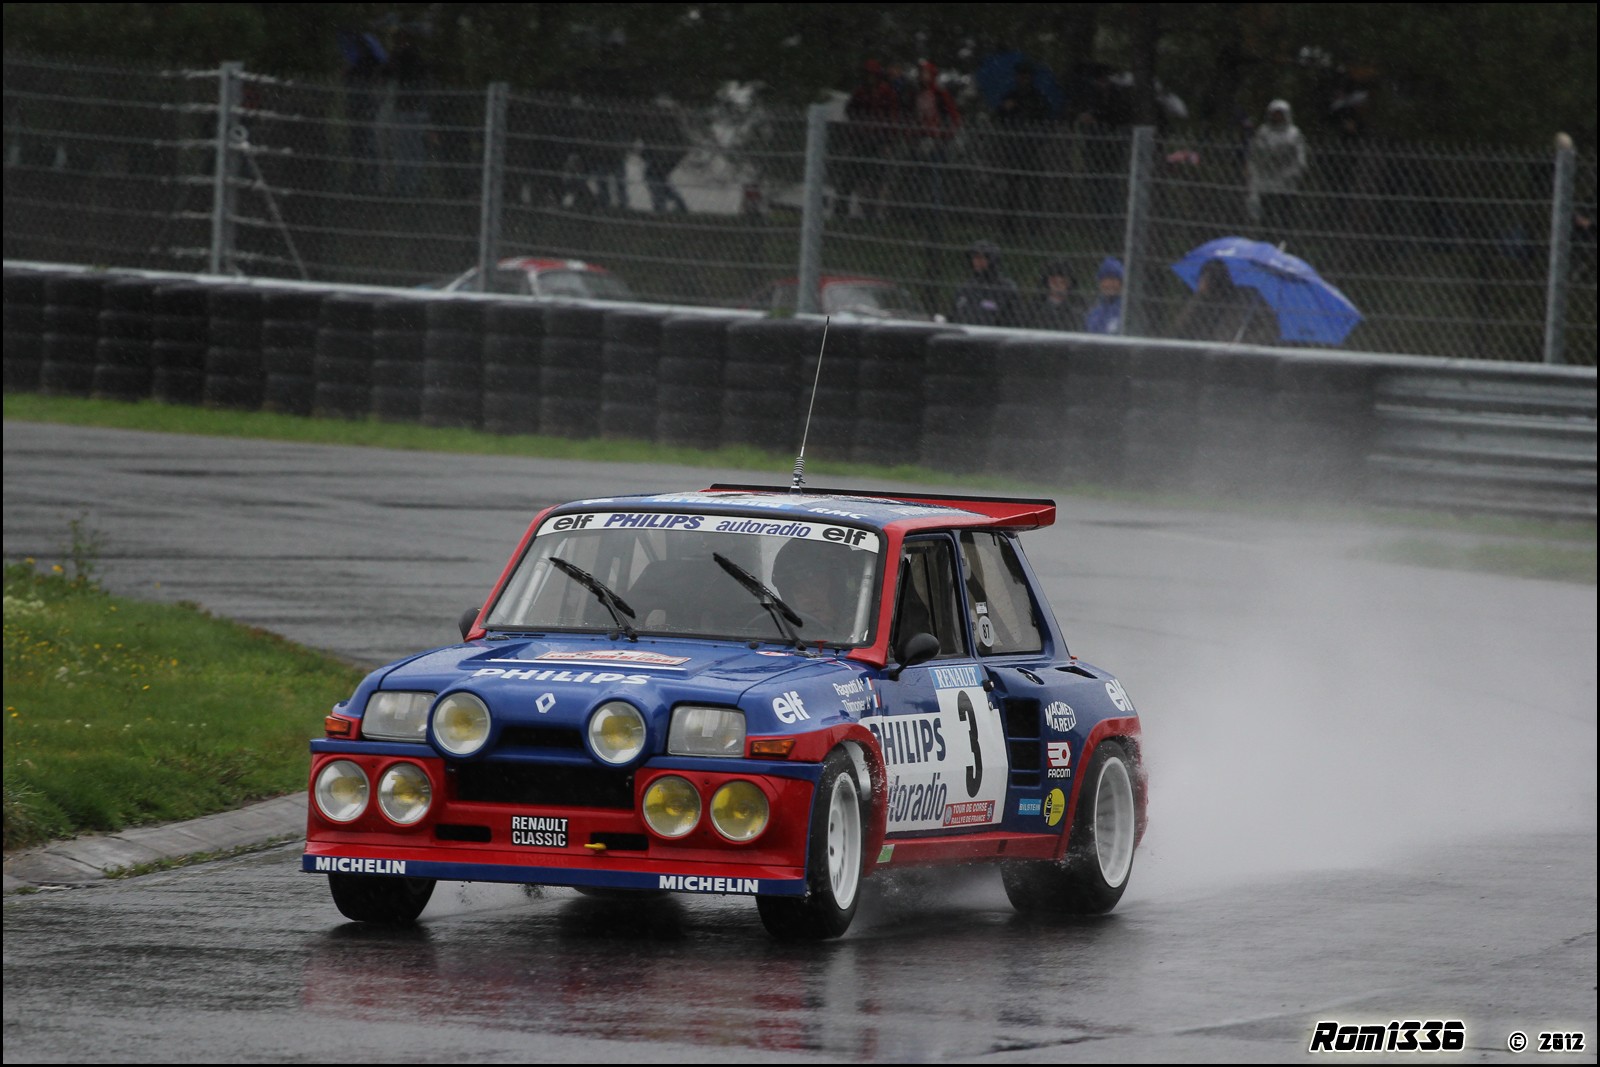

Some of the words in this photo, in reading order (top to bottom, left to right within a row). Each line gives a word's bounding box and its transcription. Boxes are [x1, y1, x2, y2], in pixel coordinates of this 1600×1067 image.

[807, 506, 869, 520] RMC
[552, 514, 595, 531] elf
[602, 513, 706, 530] PHILIPS
[715, 519, 812, 538] autoradio
[821, 527, 867, 547] elf
[471, 667, 652, 685] PHILIPS
[933, 666, 979, 689] RENAULT
[1105, 679, 1134, 712] elf
[772, 691, 812, 724] elf
[957, 690, 983, 798] 3
[1047, 768, 1071, 778] FACOM
[885, 772, 948, 822] toradio
[953, 804, 966, 814] TOUR
[973, 802, 988, 812] CORSE
[512, 816, 568, 832] RENAULT
[951, 815, 966, 825] RALLYE
[971, 814, 986, 823] FRANCE
[512, 831, 567, 847] CLASSIC
[315, 856, 407, 874] MICHELIN
[659, 875, 759, 893] MICHELIN
